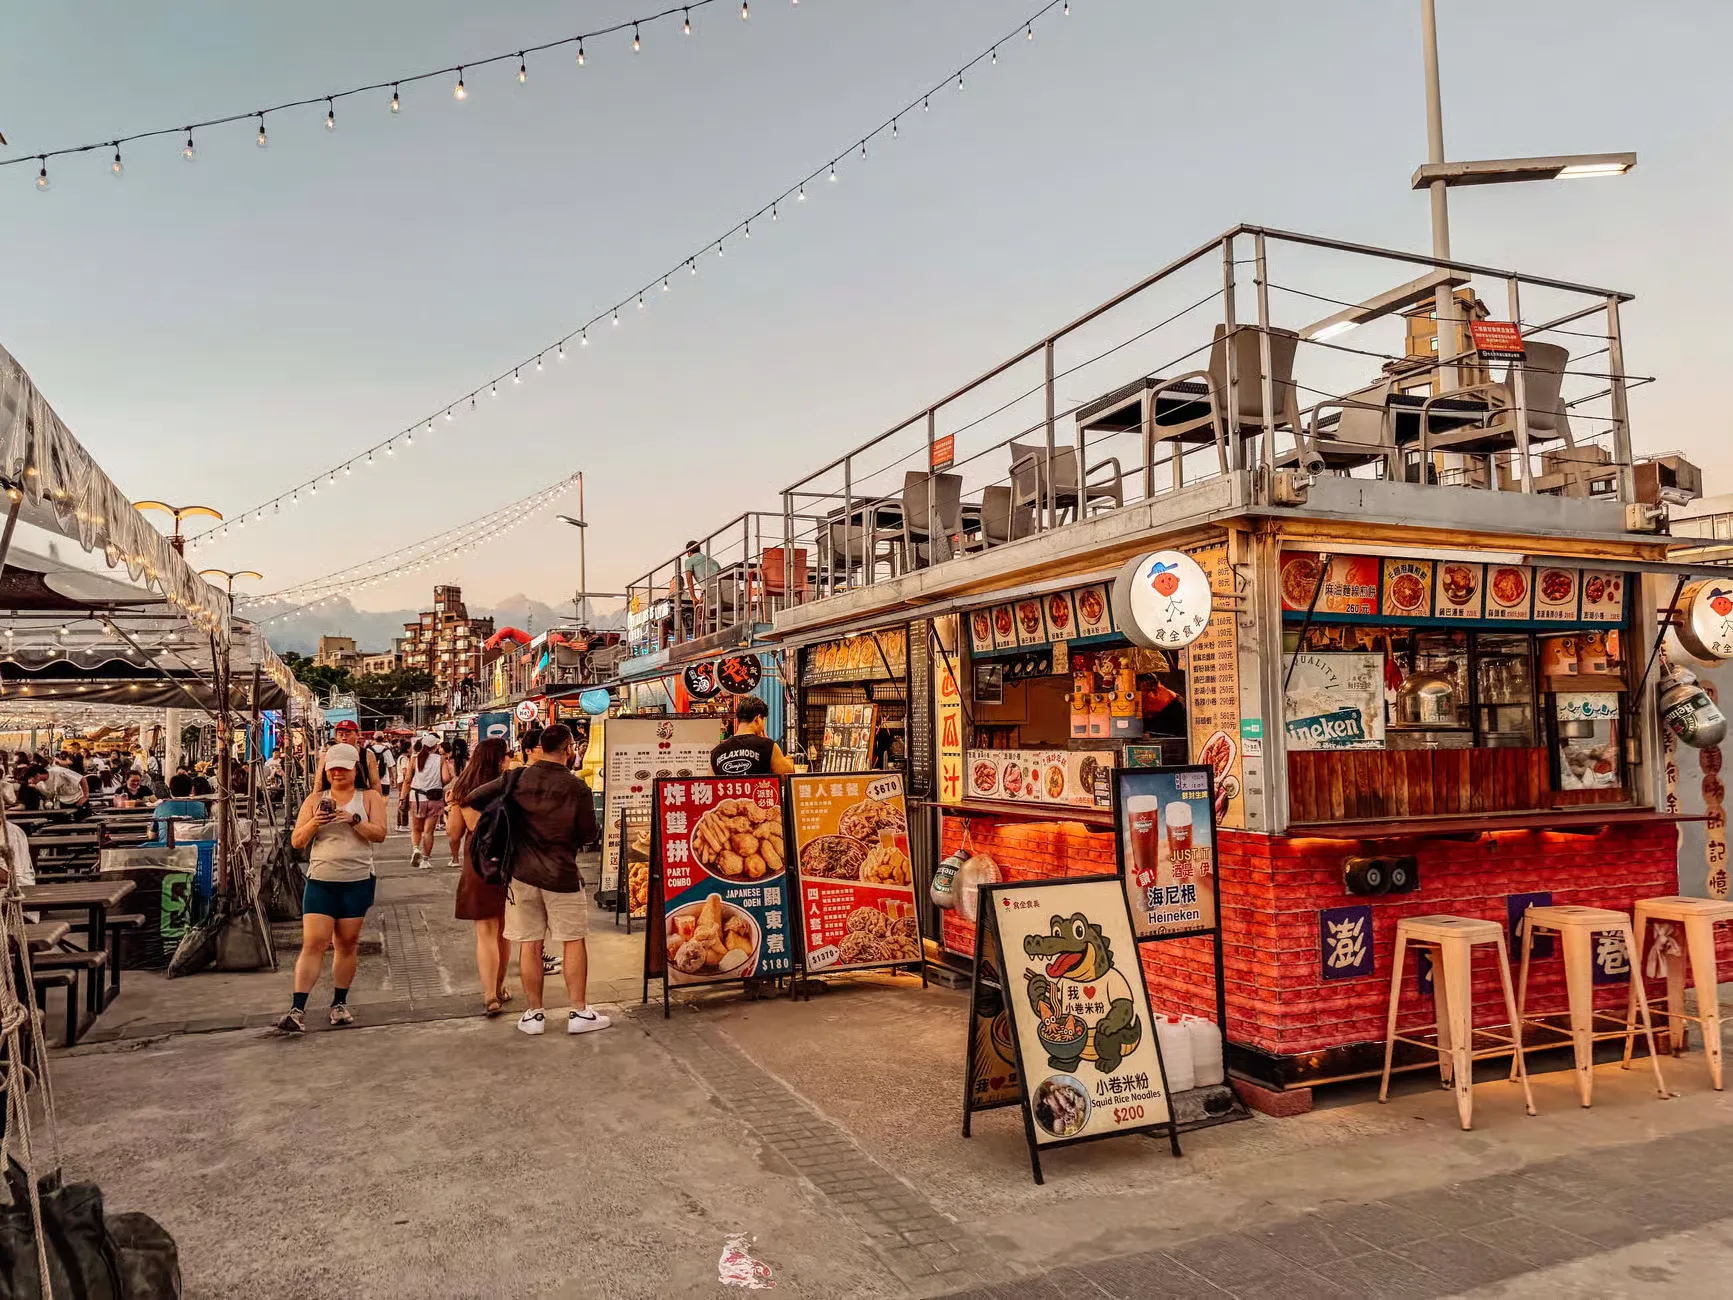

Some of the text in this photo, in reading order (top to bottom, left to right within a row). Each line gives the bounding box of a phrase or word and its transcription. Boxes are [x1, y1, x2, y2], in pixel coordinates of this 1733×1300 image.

[1346, 604, 1359, 613] 260
[942, 665, 960, 798] 西瓜汁
[664, 783, 713, 806] 炸物
[717, 783, 751, 796] $350
[874, 781, 897, 795] $670
[665, 811, 689, 863] 雙拼
[1170, 847, 1210, 862] JUST IT
[667, 867, 690, 877] PARTY
[1172, 863, 1194, 878] 酒是
[667, 878, 691, 888] COMBO
[726, 888, 761, 899] JAPANESE
[1147, 883, 1197, 907] 海尼根
[743, 898, 761, 908] ODEN
[763, 887, 785, 954] 關東煮
[807, 888, 823, 946] 四人套餐
[1148, 909, 1199, 924] Heineken
[1327, 916, 1366, 969] 澎
[812, 949, 834, 964] $1370
[762, 958, 789, 971] $180
[1067, 986, 1080, 1000] 我
[1065, 1002, 1105, 1015] 小卷米粉
[1096, 1072, 1149, 1096] 小卷米粉
[1092, 1090, 1161, 1108] Squid Rice Noodles
[1113, 1105, 1145, 1125] $200
